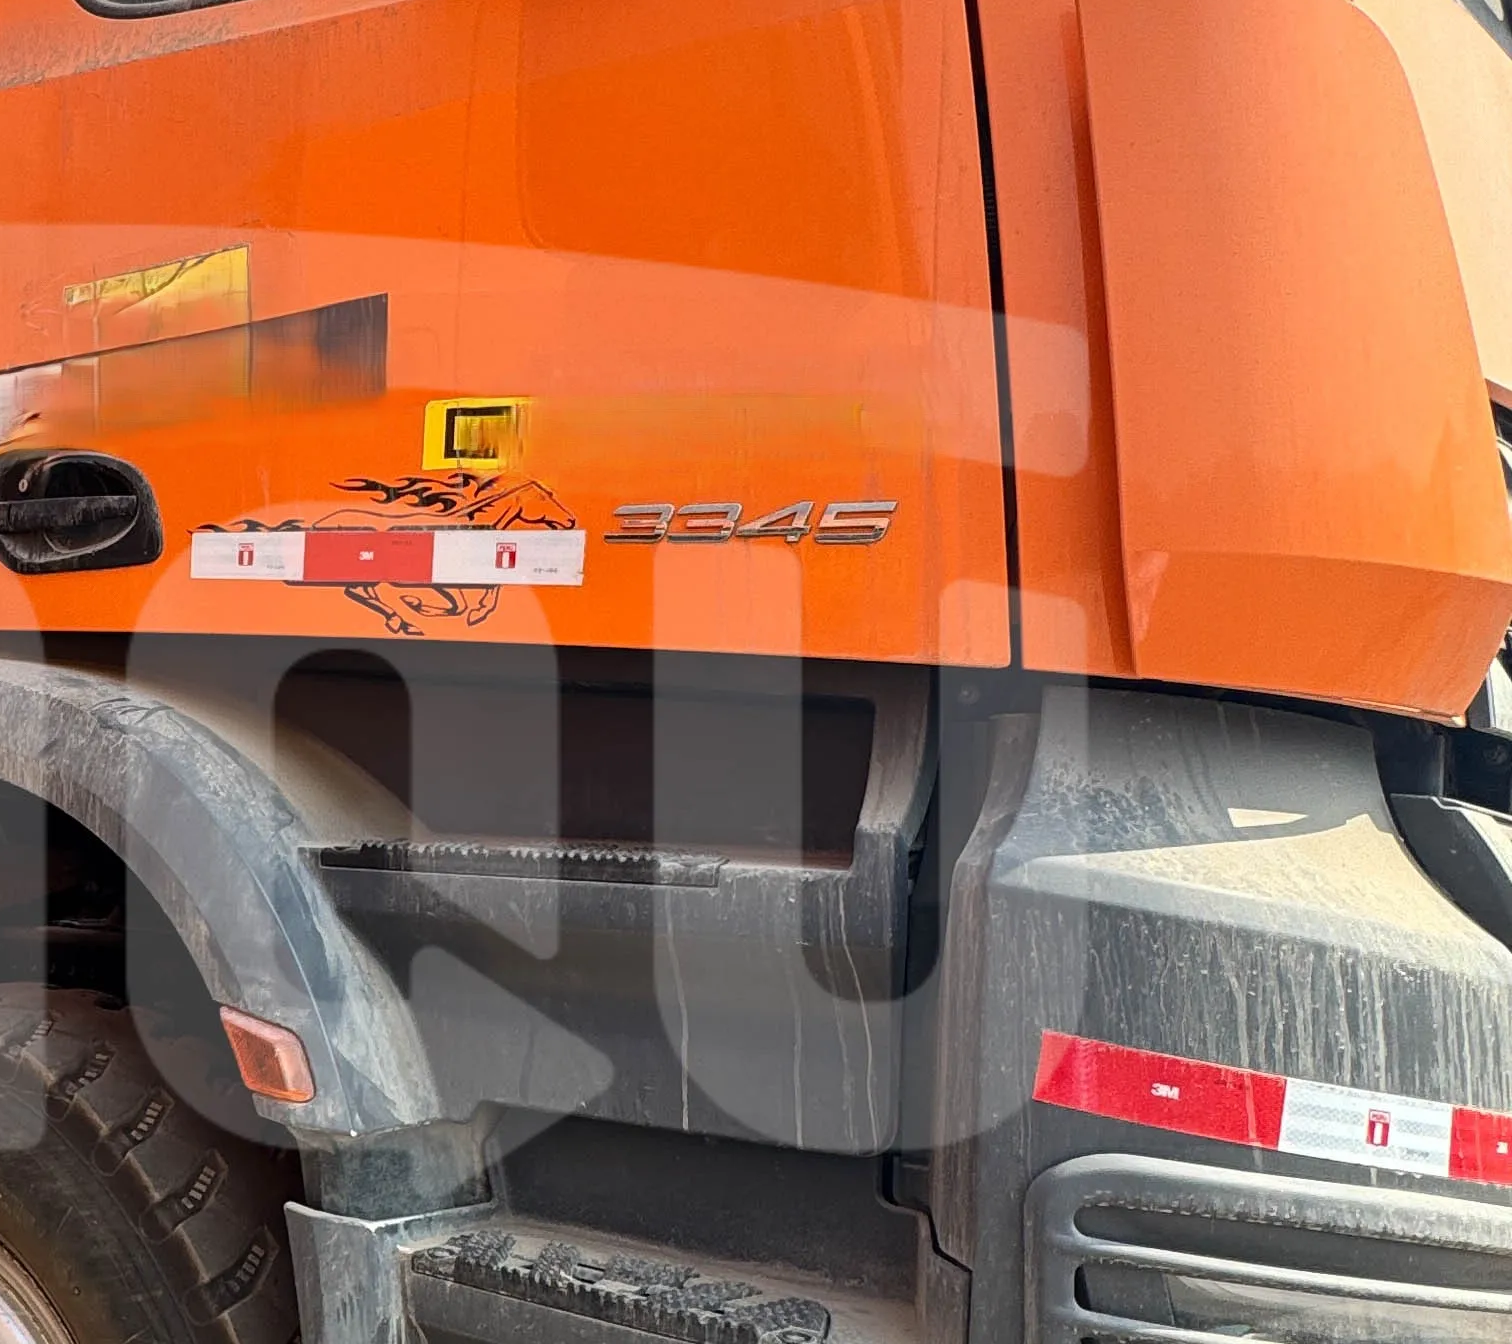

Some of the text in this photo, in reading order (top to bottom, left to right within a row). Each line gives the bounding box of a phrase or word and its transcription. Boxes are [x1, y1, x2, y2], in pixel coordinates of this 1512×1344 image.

[603, 499, 899, 544] 3345
[359, 551, 374, 561] 3M
[1150, 1082, 1180, 1100] 3M
